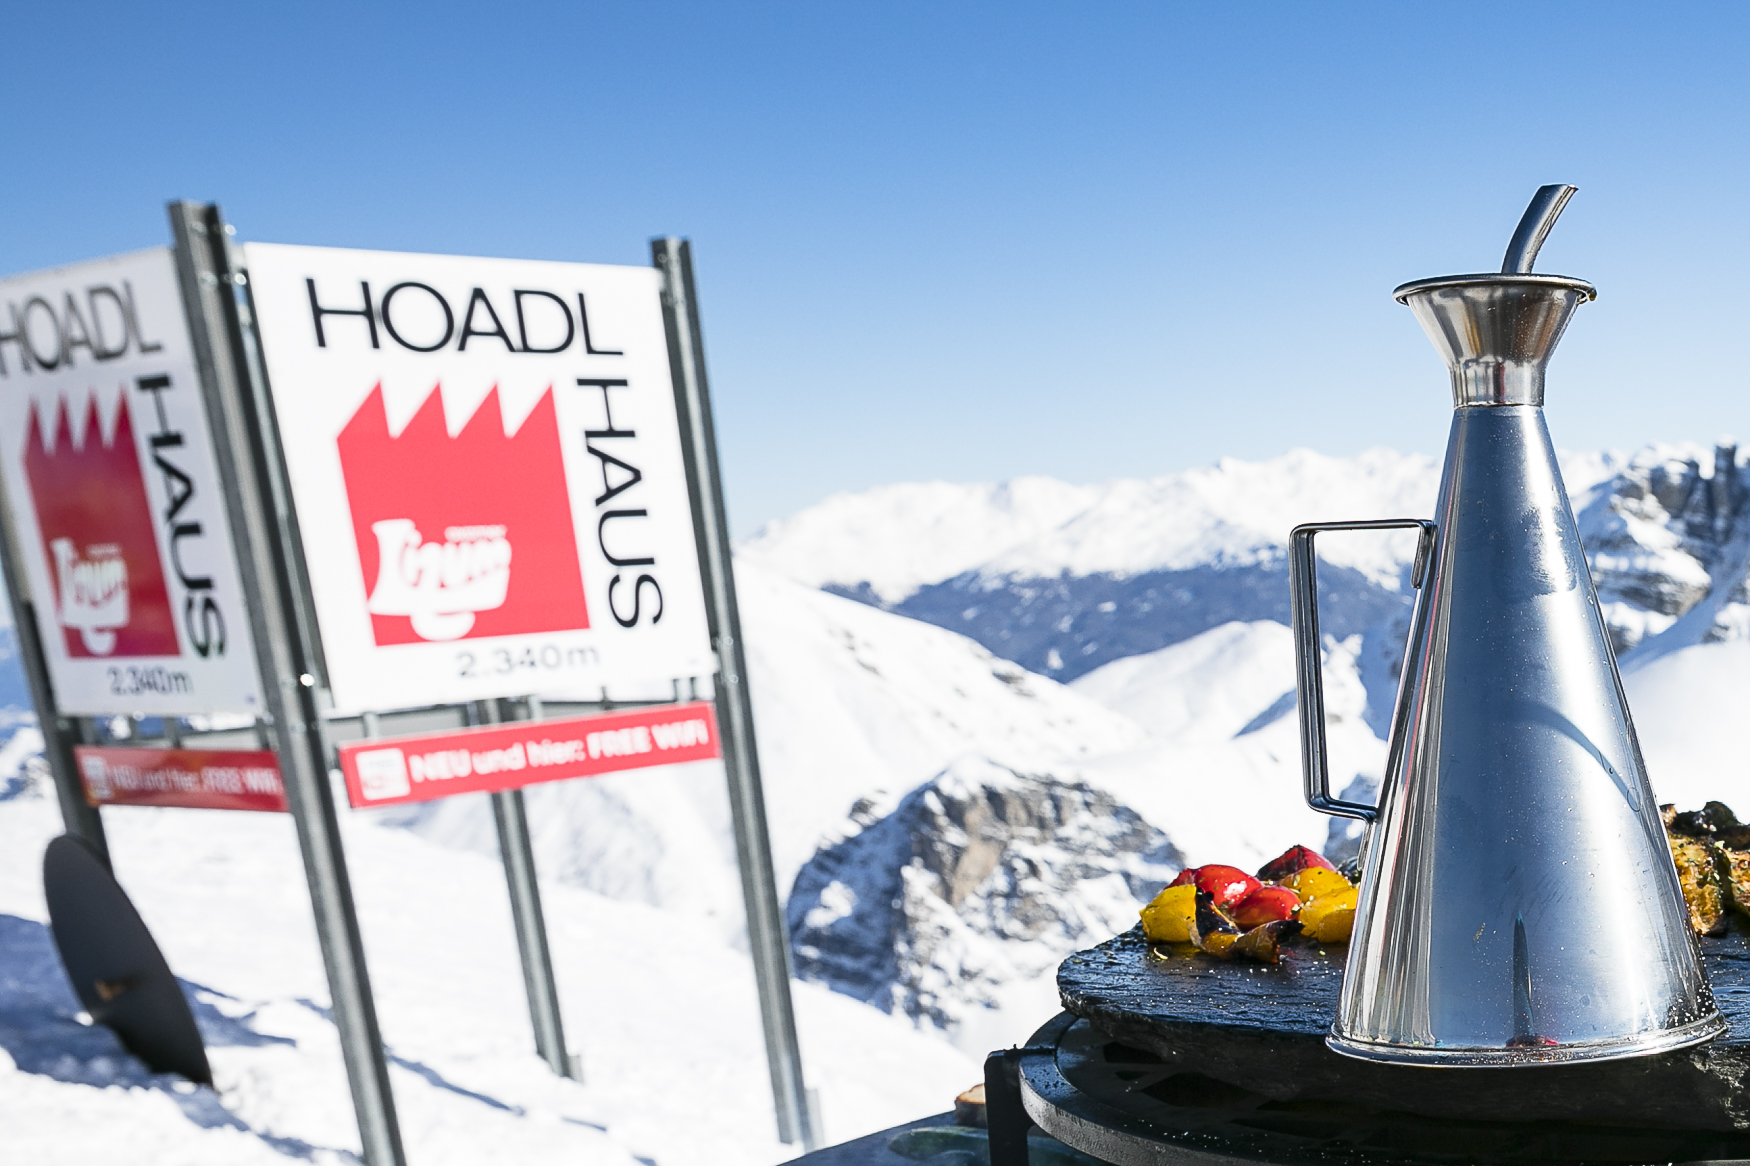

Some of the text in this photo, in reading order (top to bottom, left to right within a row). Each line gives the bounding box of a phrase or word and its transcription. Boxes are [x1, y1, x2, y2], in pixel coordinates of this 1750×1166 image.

[0, 279, 163, 377] HOADL
[306, 278, 624, 356] HOADL
[136, 375, 226, 659] HAUS
[576, 376, 664, 629] HAUS
[408, 749, 472, 783] NEU
[471, 742, 527, 775] und
[586, 725, 652, 759] FREE
